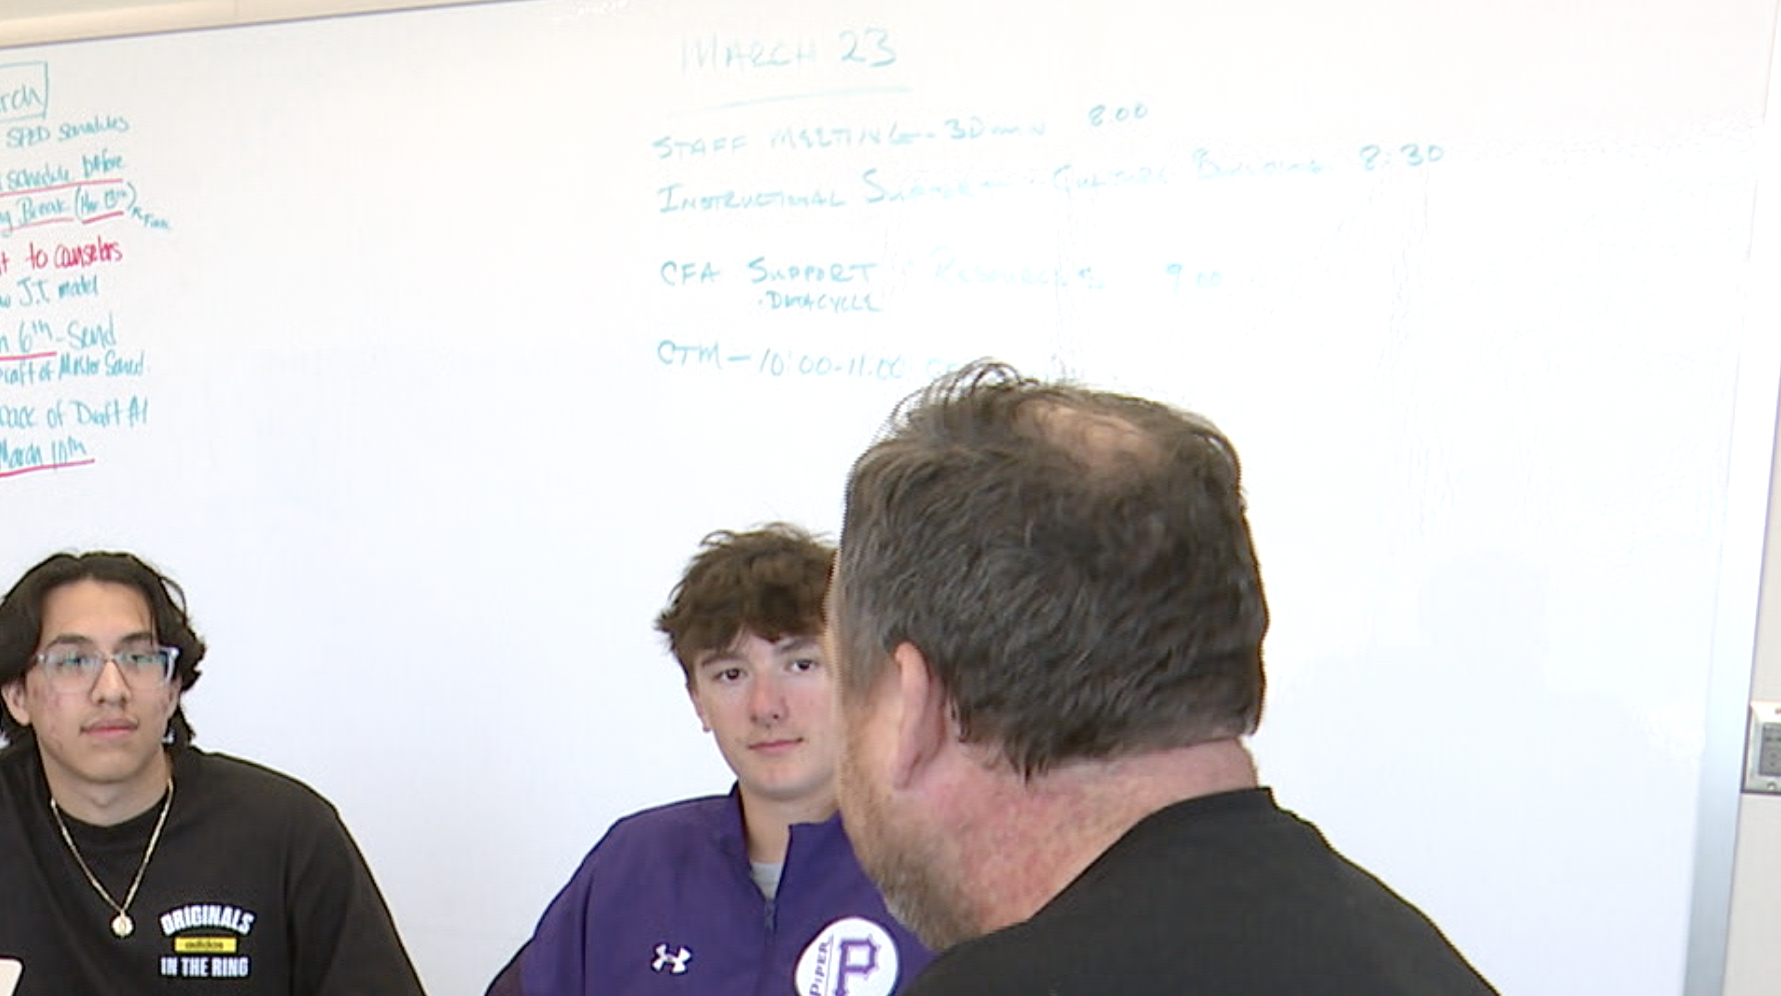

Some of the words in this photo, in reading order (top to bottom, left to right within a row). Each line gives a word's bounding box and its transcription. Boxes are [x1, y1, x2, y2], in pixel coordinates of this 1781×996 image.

[837, 27, 899, 68] 23
[25, 242, 48, 271] to
[659, 259, 719, 286] CFA
[47, 399, 64, 428] of
[160, 905, 255, 936] ORIGINALS
[160, 956, 179, 976] IN
[181, 956, 209, 977] THE
[211, 956, 249, 977] RING
